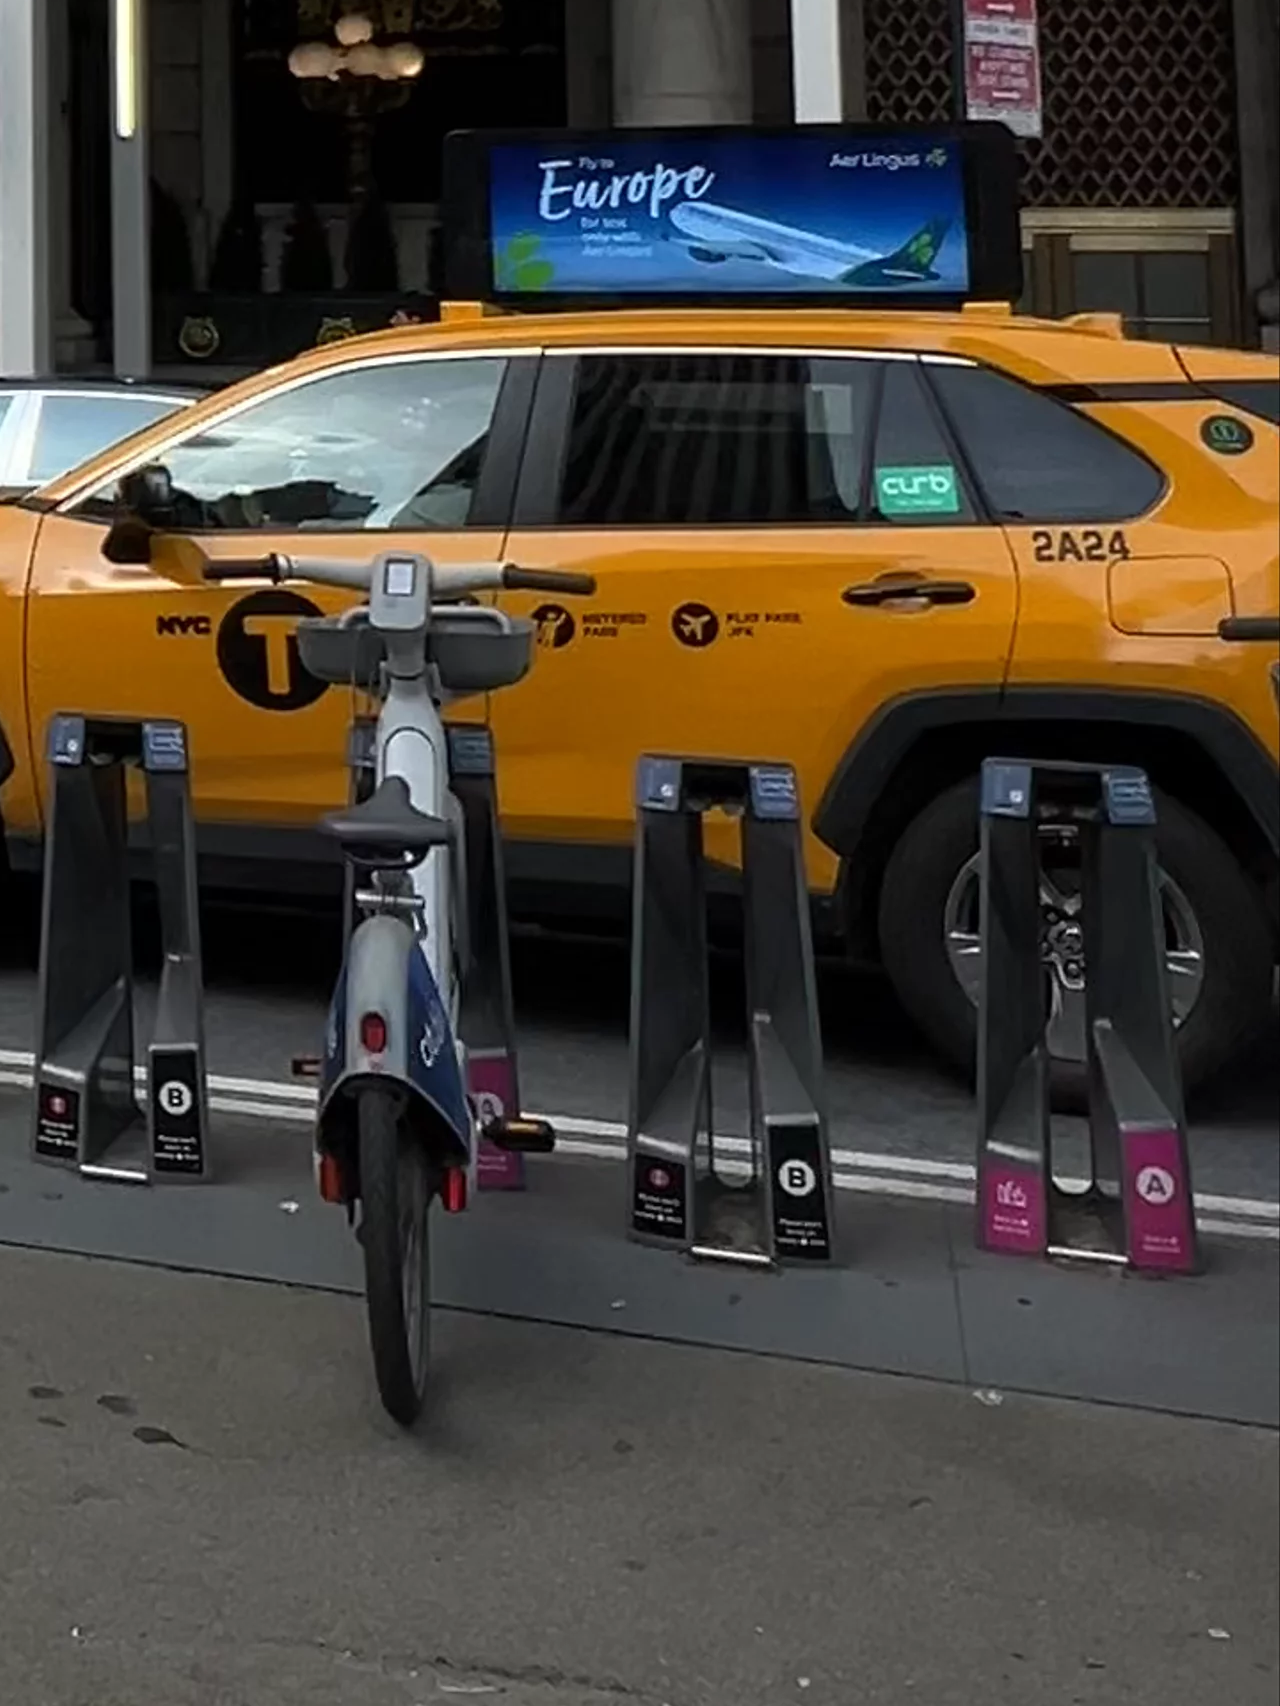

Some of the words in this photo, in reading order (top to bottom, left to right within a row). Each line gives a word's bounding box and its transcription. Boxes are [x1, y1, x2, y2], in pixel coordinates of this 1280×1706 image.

[829, 153, 860, 168] Aer
[861, 152, 920, 171] Lingus
[538, 160, 716, 221] Europe
[882, 473, 951, 495] curb
[1032, 530, 1130, 562] 2A24
[156, 615, 211, 635] NYC
